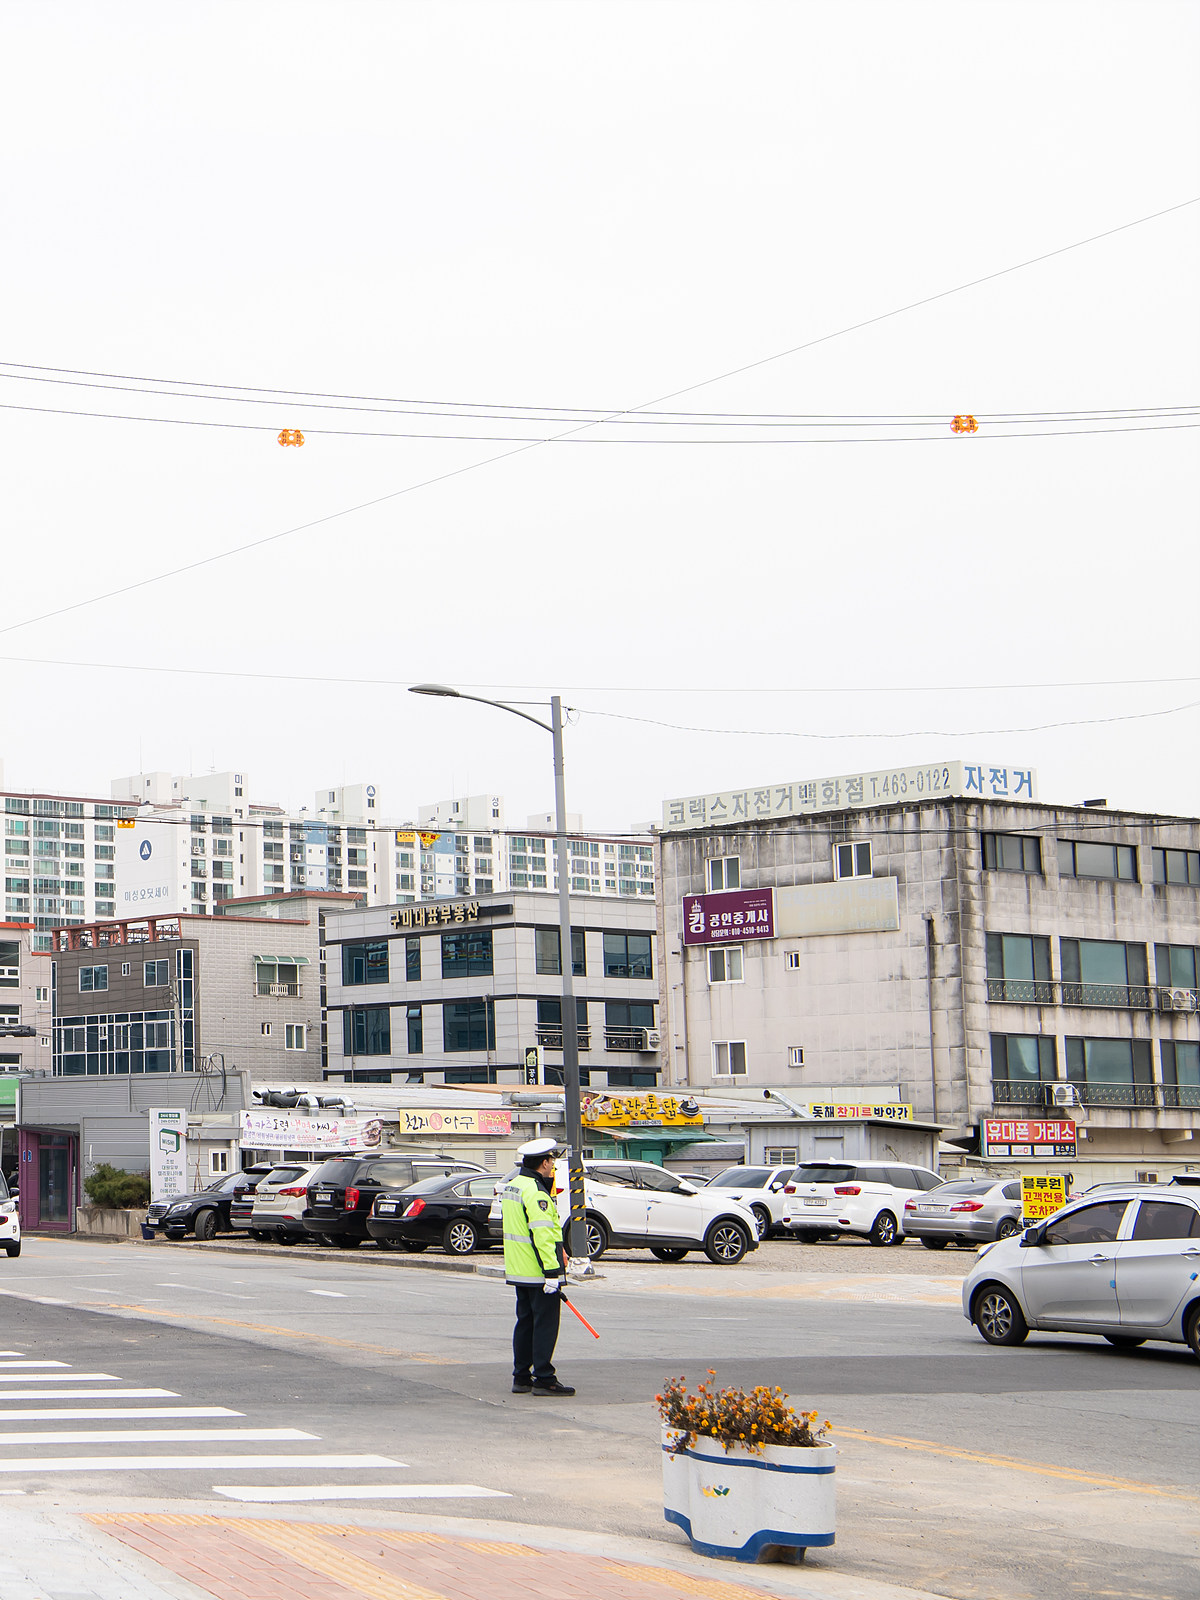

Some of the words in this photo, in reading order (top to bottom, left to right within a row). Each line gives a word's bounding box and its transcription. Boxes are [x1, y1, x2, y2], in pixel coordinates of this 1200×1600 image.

[964, 765, 1033, 799] 자전거
[390, 901, 480, 930] 구미대표부동산
[688, 912, 706, 934] 킹
[709, 909, 769, 928] 공인중개사
[611, 1094, 677, 1118] 노랑통닭
[987, 1121, 1029, 1141] 휴대폰
[1033, 1122, 1074, 1141] 거래소
[1023, 1177, 1062, 1190] 블루원
[1023, 1191, 1063, 1203] 고객전용
